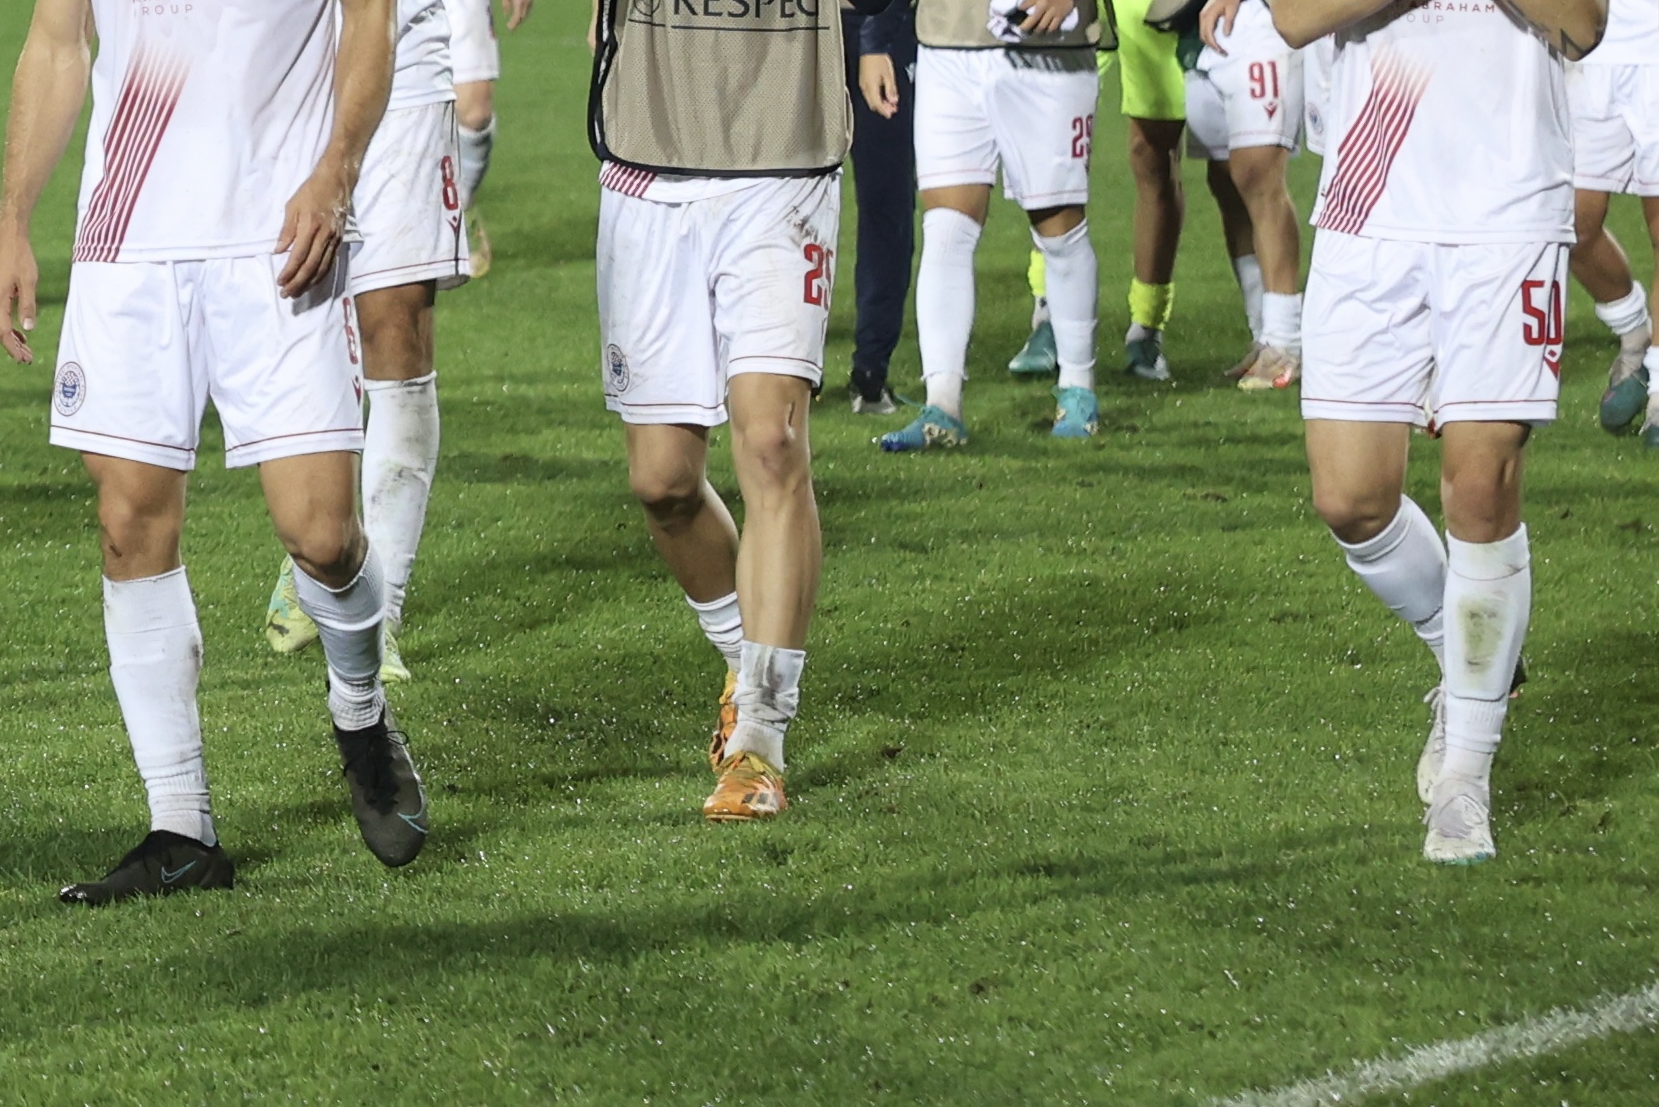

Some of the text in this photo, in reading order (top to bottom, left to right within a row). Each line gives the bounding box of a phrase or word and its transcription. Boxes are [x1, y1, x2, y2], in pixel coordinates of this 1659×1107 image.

[133, 3, 194, 18] ROUP
[1249, 60, 1279, 100] 91
[1520, 279, 1562, 346] 50
